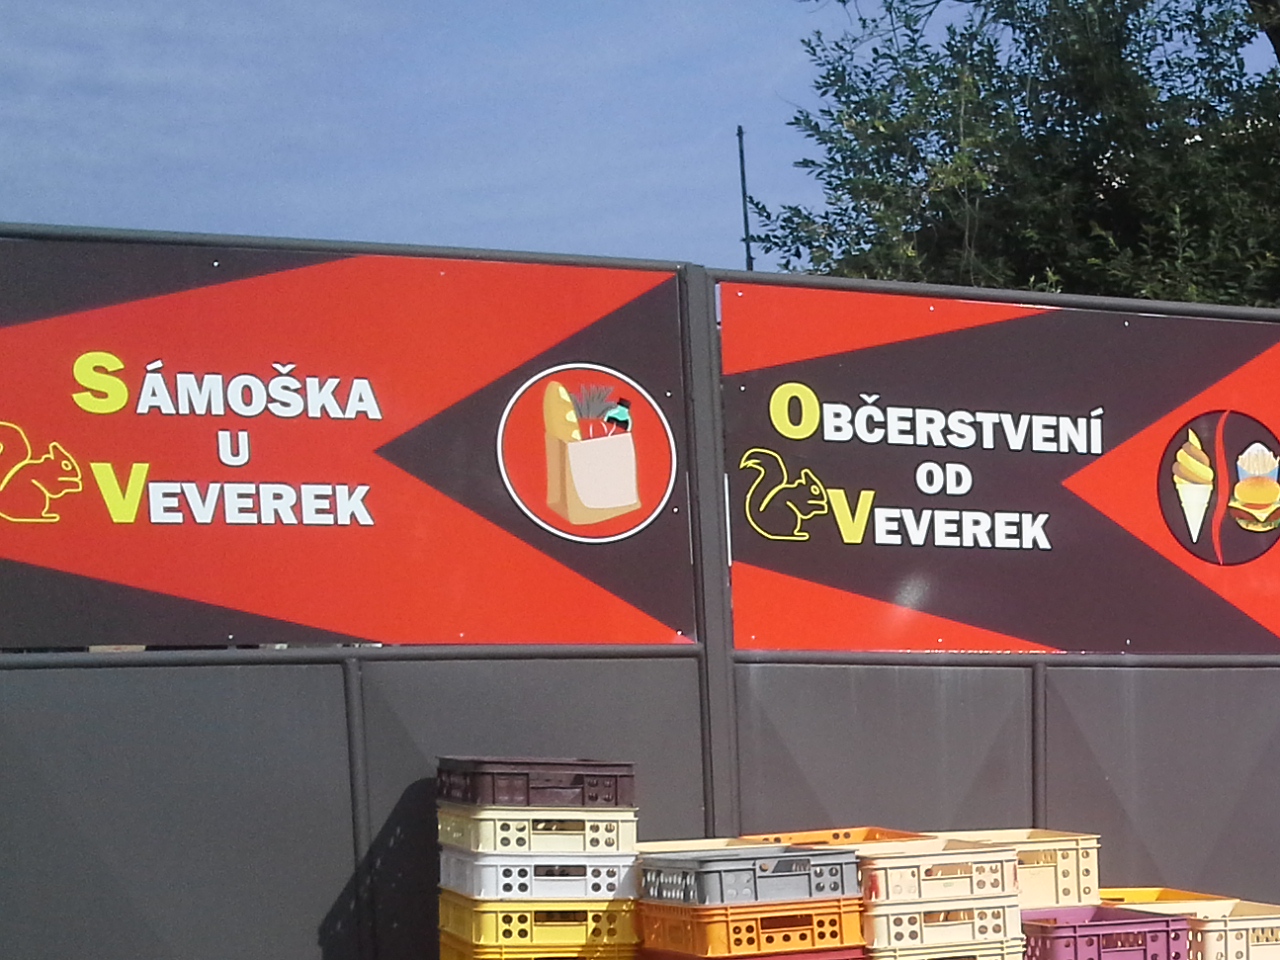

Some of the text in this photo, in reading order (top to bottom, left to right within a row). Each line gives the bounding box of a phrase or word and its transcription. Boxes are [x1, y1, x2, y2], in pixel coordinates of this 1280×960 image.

[72, 351, 382, 419] SÁMOŠKA
[217, 430, 250, 466] U
[769, 381, 1104, 454] OBČERSTVENÍ
[90, 462, 374, 525] VEVEREK
[916, 462, 973, 495] OD
[826, 489, 1052, 550] VEVEREK
